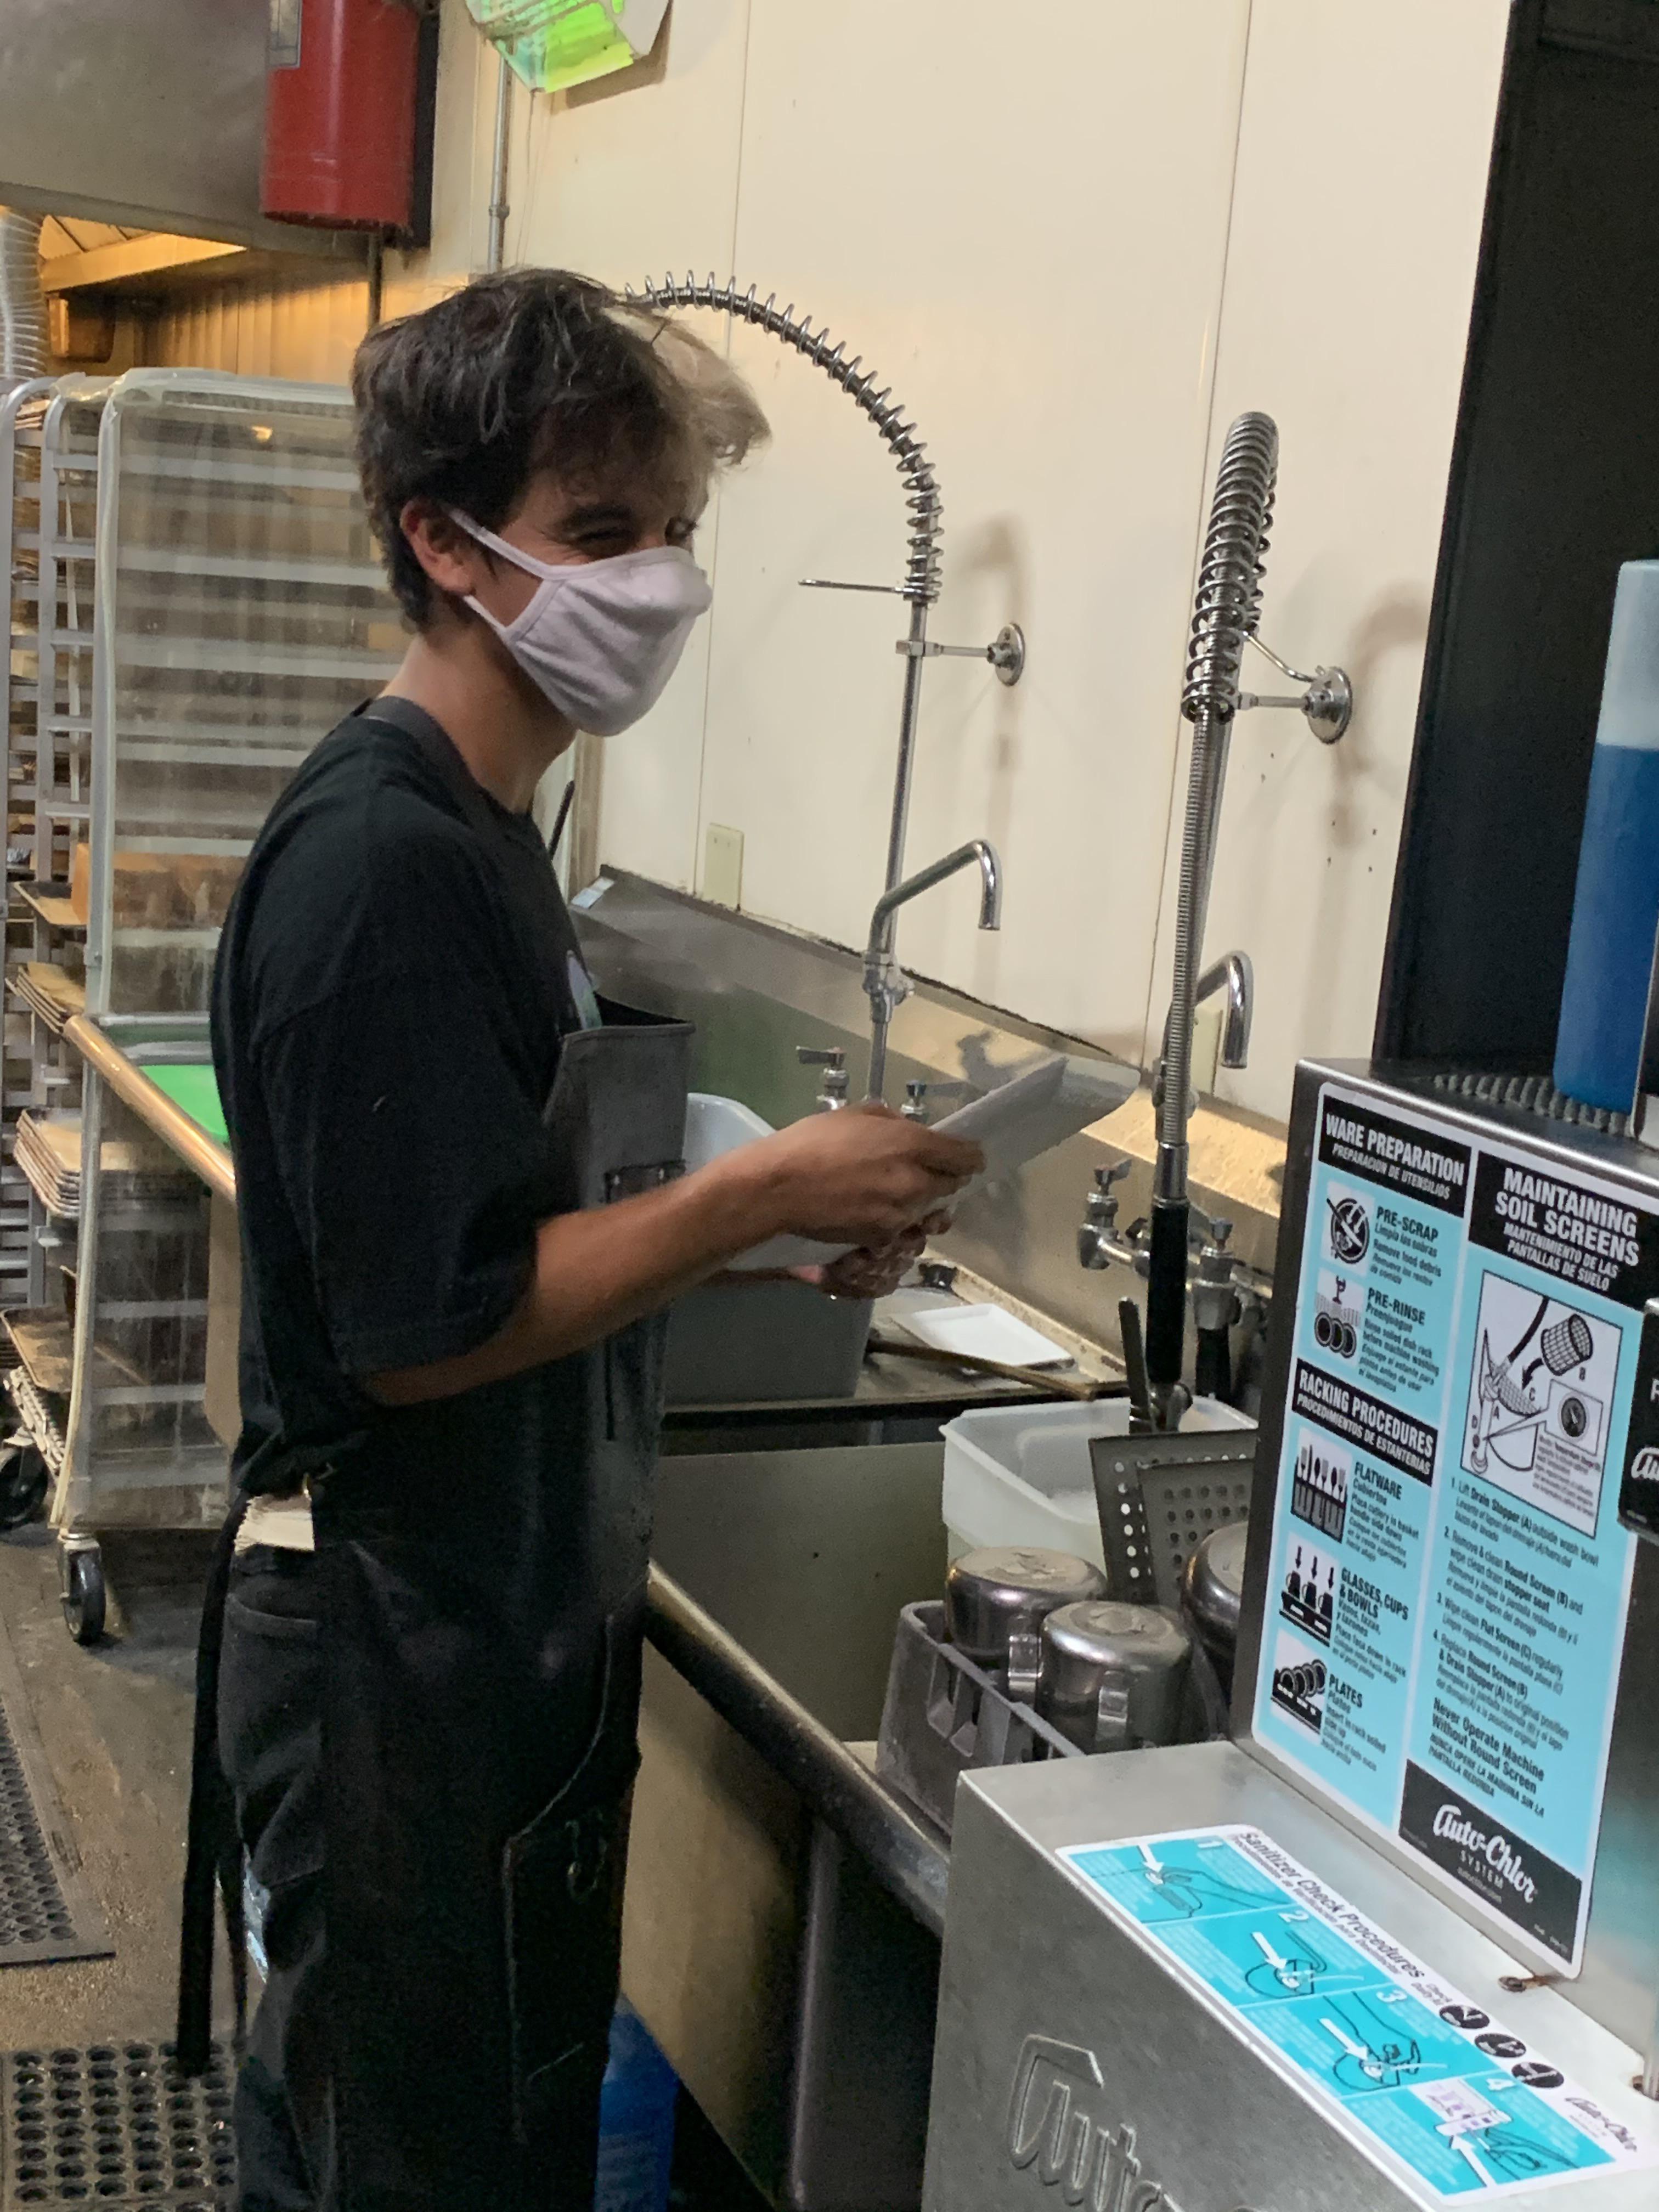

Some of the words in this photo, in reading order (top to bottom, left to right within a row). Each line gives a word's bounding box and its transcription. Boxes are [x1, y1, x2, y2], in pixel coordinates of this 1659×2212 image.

[1324, 1113, 1365, 1148] WARE
[1367, 1128, 1465, 1186] PREPARATION
[1387, 1164, 1400, 1180] DE
[1401, 1169, 1451, 1201] UTENSILIOS
[1502, 1166, 1639, 1239] MAINTAINING
[1375, 1205, 1439, 1244] PRE-SCRAP
[1494, 1189, 1539, 1229] SOIL
[1543, 1208, 1641, 1269] SCREENS
[1503, 1220, 1582, 1266] MANTENIMIENTO
[1582, 1252, 1598, 1272] DE
[1598, 1258, 1618, 1280] LAS
[1506, 1238, 1560, 1272] PANTALLAS
[1561, 1260, 1576, 1279] DE
[1577, 1267, 1610, 1293] SUELO
[1367, 1286, 1426, 1326] PRE-RINSE
[1299, 1368, 1350, 1414] RACKING
[1351, 1395, 1435, 1459] PROCEDURES
[1493, 1406, 1499, 1420] A
[1529, 1387, 1536, 1402] C
[1296, 1392, 1363, 1439] PROCEDIMIENTOS
[1363, 1428, 1375, 1446] DE
[1375, 1434, 1431, 1476] ESTANTERIAS
[1353, 1460, 1403, 1501] FLATWARE
[1339, 1583, 1347, 1599] &
[1347, 1588, 1379, 1620] BOWLS
[1340, 1566, 1384, 1607] GLASSES,
[1384, 1593, 1409, 1622] CUPS
[1328, 1673, 1363, 1709] PLATES
[1431, 1712, 1468, 1748] Without
[1469, 1737, 1500, 1771] Round
[1502, 1759, 1537, 1796] Screen
[1433, 1696, 1460, 1726] Never
[1462, 1716, 1500, 1754] Operate
[1502, 1741, 1545, 1782] Machine
[1433, 1804, 1536, 1903] Auto-Chlor
[1460, 1850, 1504, 1889] SYSTEM
[1241, 1832, 1302, 1877] Sanitizer
[1297, 1880, 1345, 1912] Check
[1340, 1913, 1424, 1978] Procedures
[1278, 1910, 1309, 1923] 2
[1376, 1989, 1408, 2003] 3
[1486, 2078, 1515, 2091] 4
